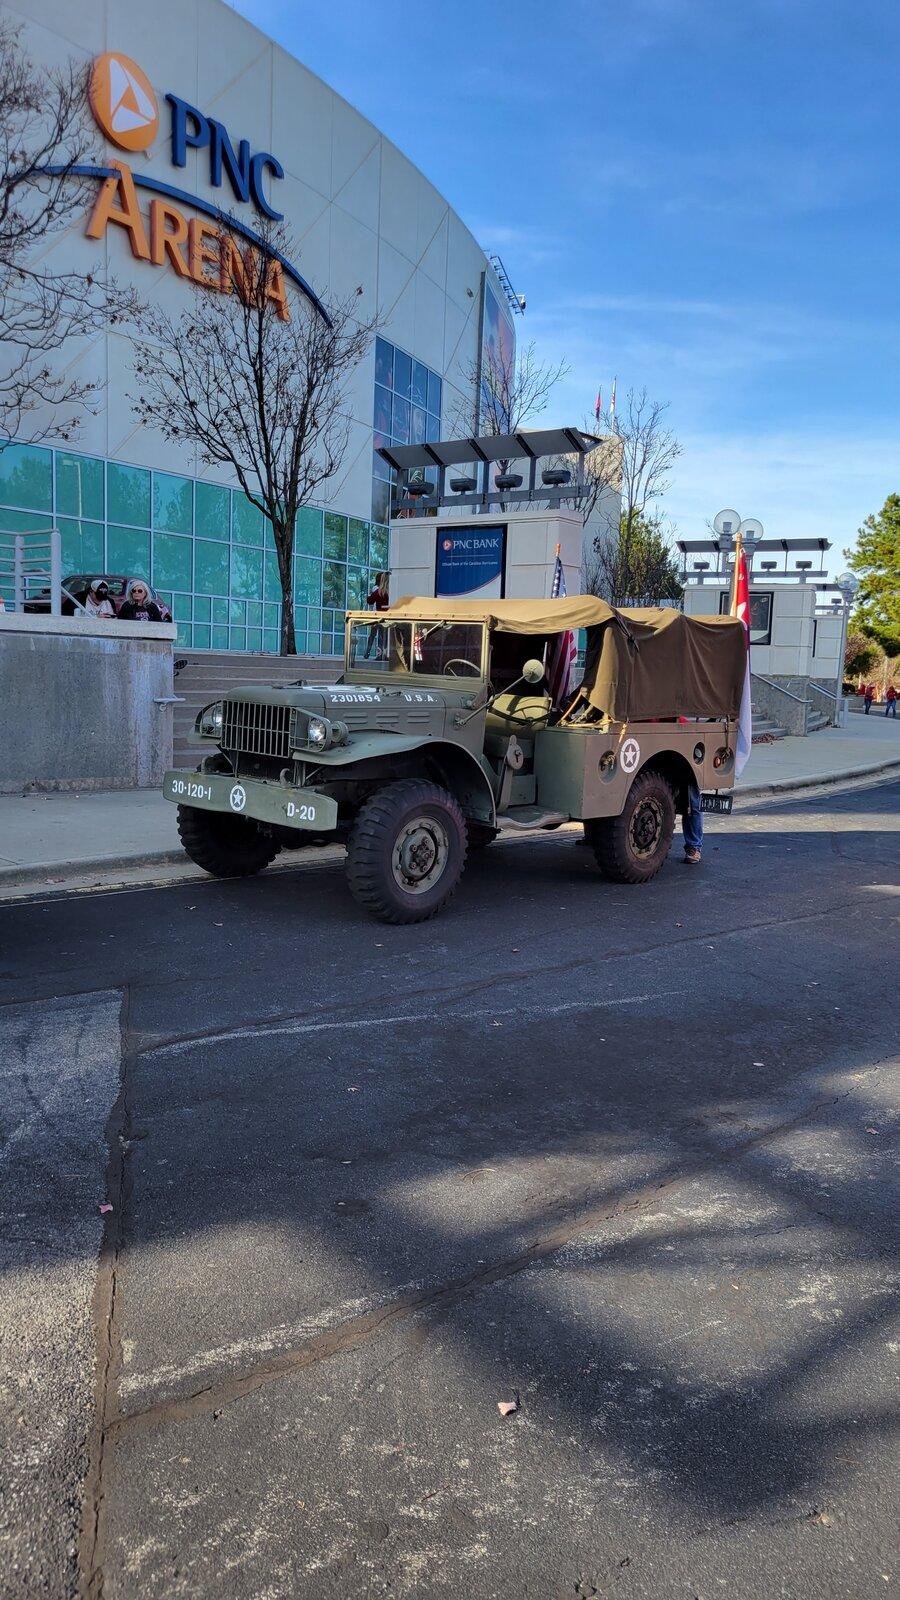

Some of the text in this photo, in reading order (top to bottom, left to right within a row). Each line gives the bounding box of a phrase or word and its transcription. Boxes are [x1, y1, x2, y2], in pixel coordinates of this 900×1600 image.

[165, 93, 284, 221] PNC
[85, 159, 290, 324] ARENA
[330, 694, 438, 703] 2301854 U.S.A.
[287, 802, 315, 820] D-20
